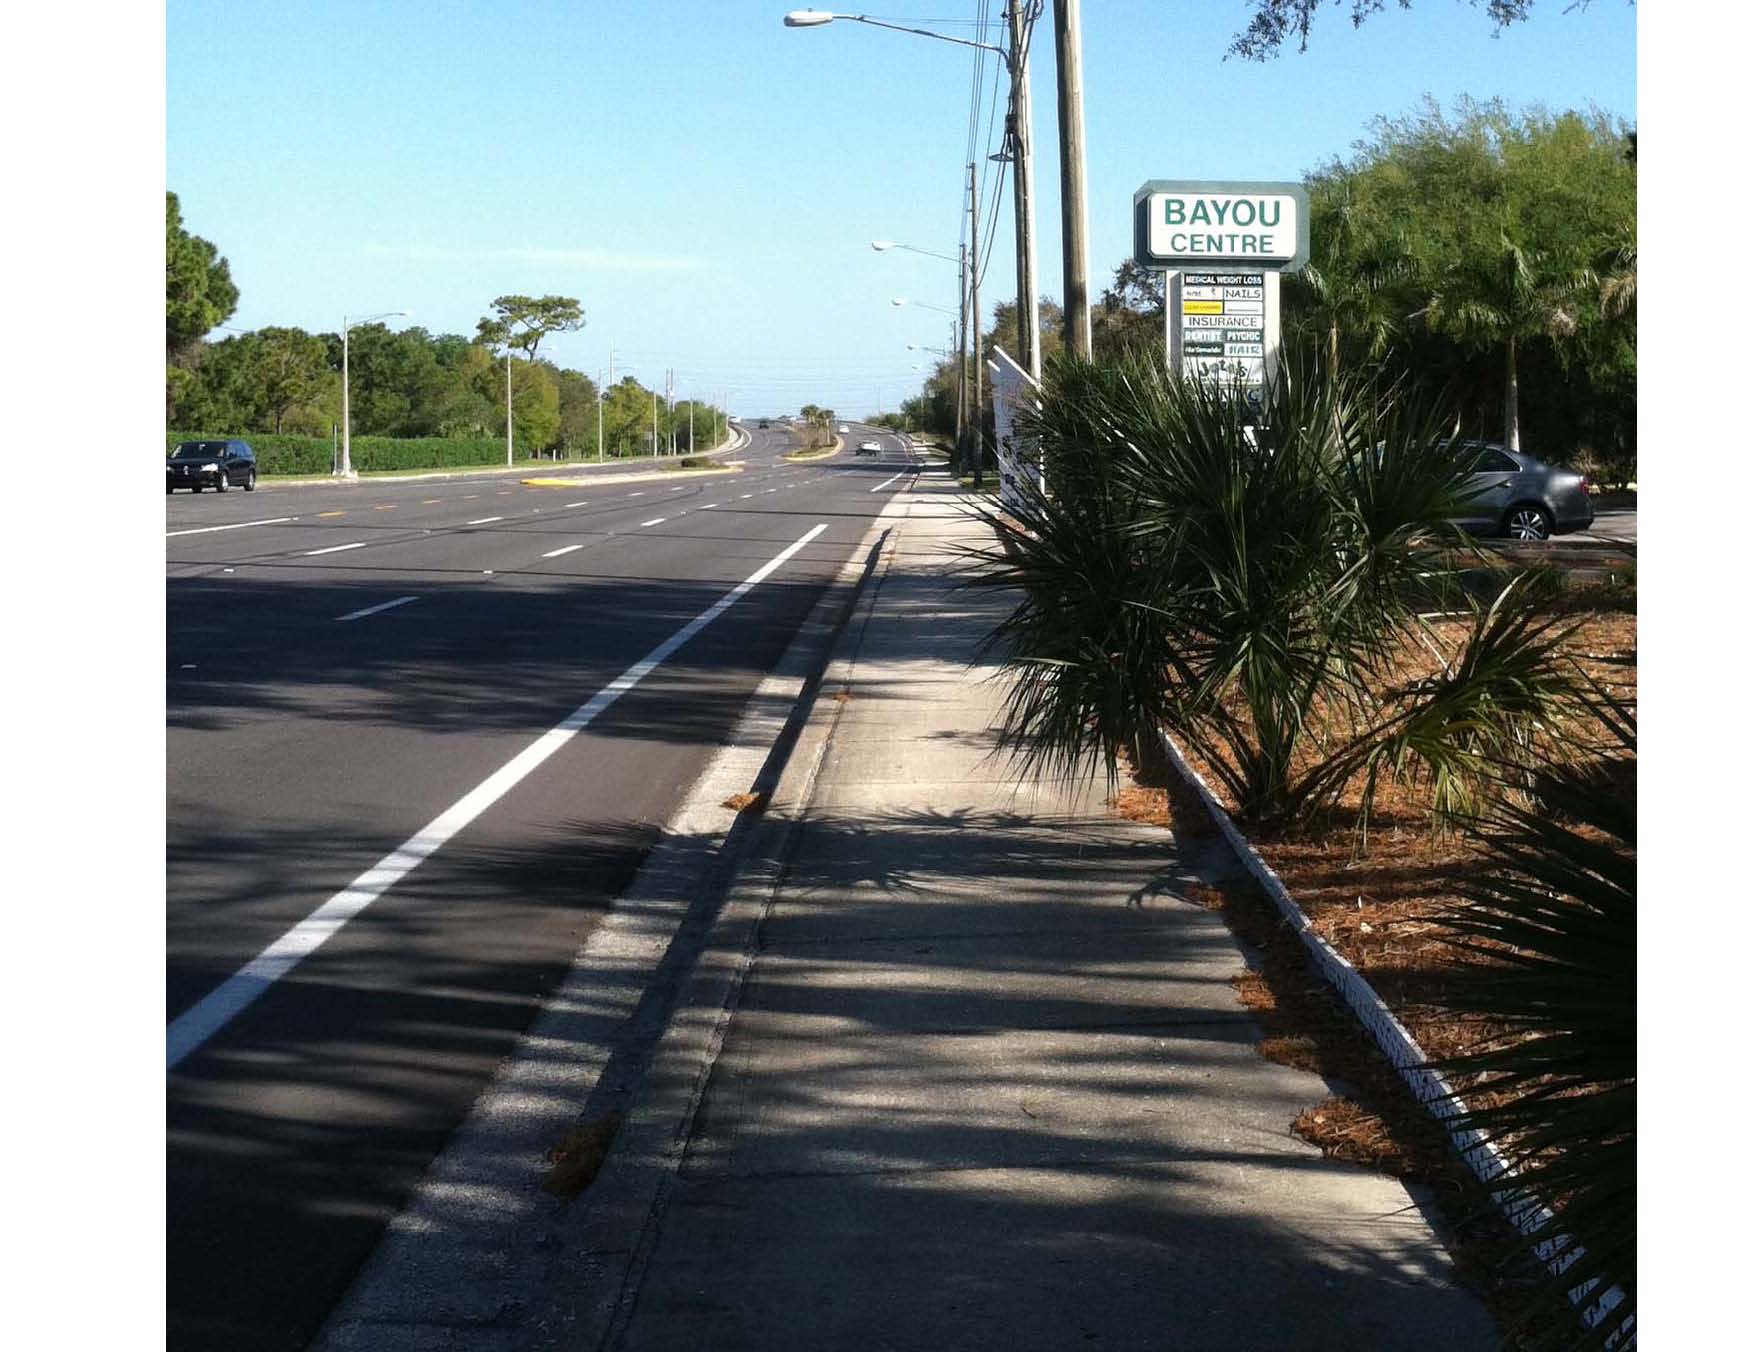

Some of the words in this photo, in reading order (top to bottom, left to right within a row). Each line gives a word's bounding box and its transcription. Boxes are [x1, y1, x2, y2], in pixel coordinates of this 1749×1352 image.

[1165, 199, 1280, 227] BAYOU
[1171, 234, 1274, 253] CENTRE
[1185, 275, 1216, 284] MEDICAL
[1217, 275, 1242, 284] WEIGHT
[1243, 275, 1262, 284] LOSS
[1225, 289, 1261, 299] NAILS
[1189, 316, 1257, 327] INSURANCE
[1227, 331, 1260, 341] PSYCHIC
